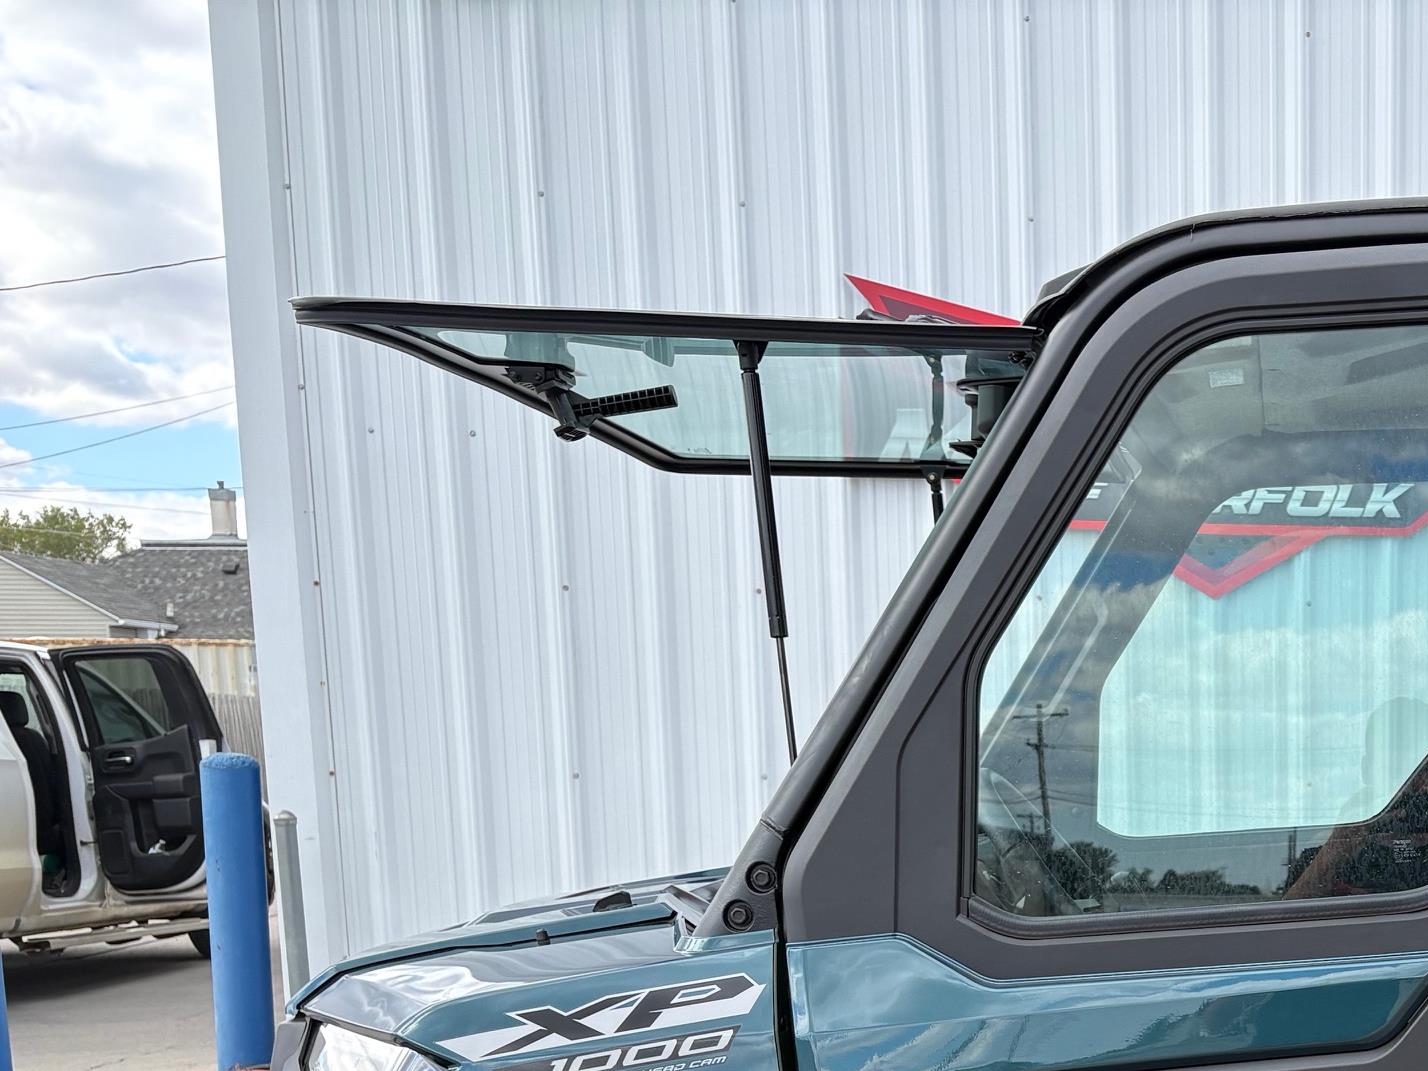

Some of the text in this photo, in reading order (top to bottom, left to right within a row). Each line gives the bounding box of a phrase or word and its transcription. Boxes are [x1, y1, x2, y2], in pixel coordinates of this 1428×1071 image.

[1212, 483, 1415, 518] RFOLK
[486, 973, 756, 1059] XP
[688, 1055, 727, 1069] CAM
